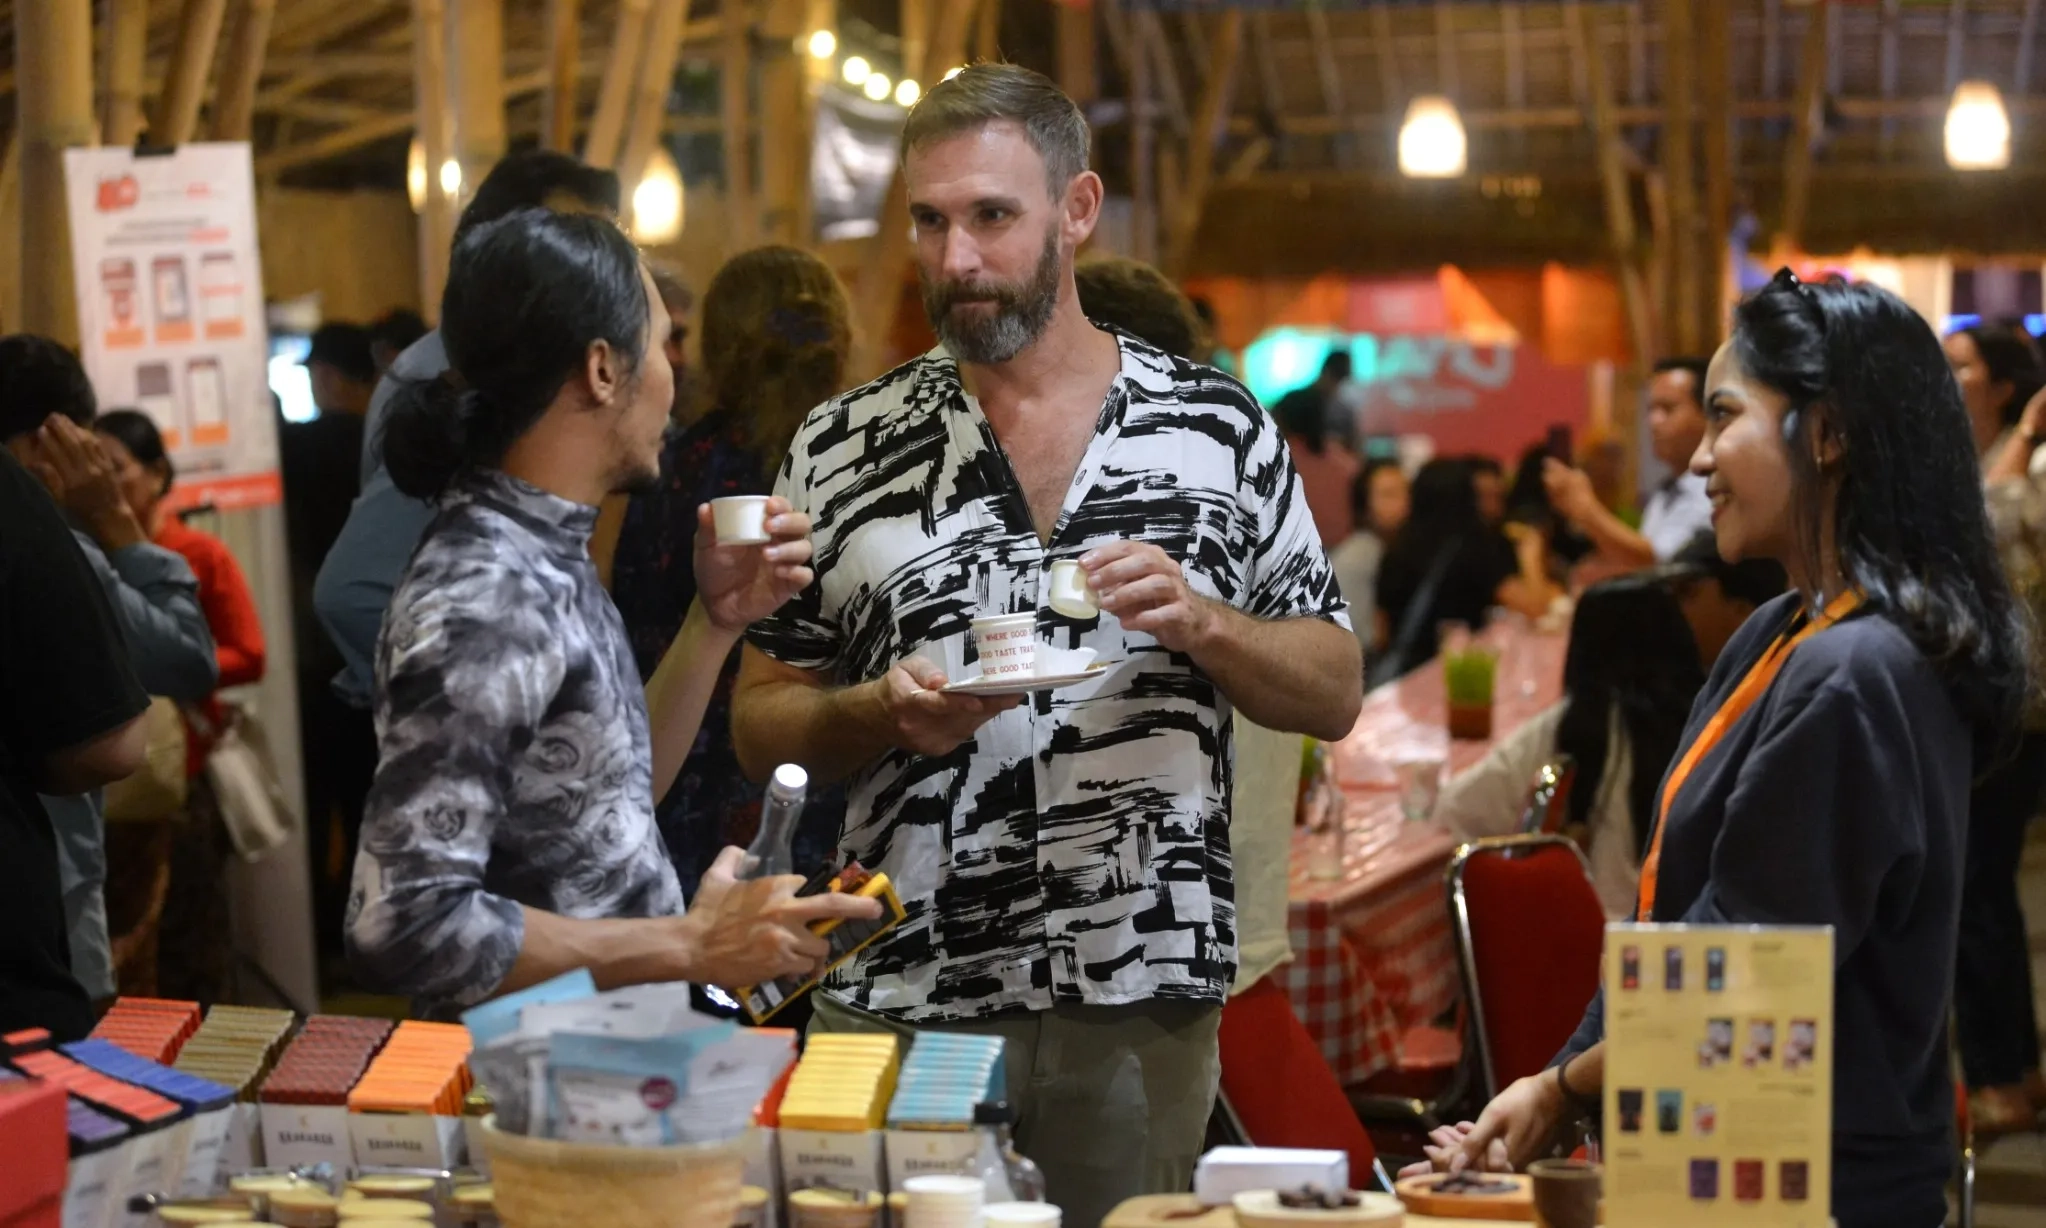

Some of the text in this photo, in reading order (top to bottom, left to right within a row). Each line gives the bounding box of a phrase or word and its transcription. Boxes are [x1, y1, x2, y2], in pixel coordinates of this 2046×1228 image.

[985, 632, 1008, 641] WHERE
[1011, 630, 1028, 639] GOOD
[995, 647, 1017, 657] TASTE
[1000, 664, 1019, 673] GOOD
